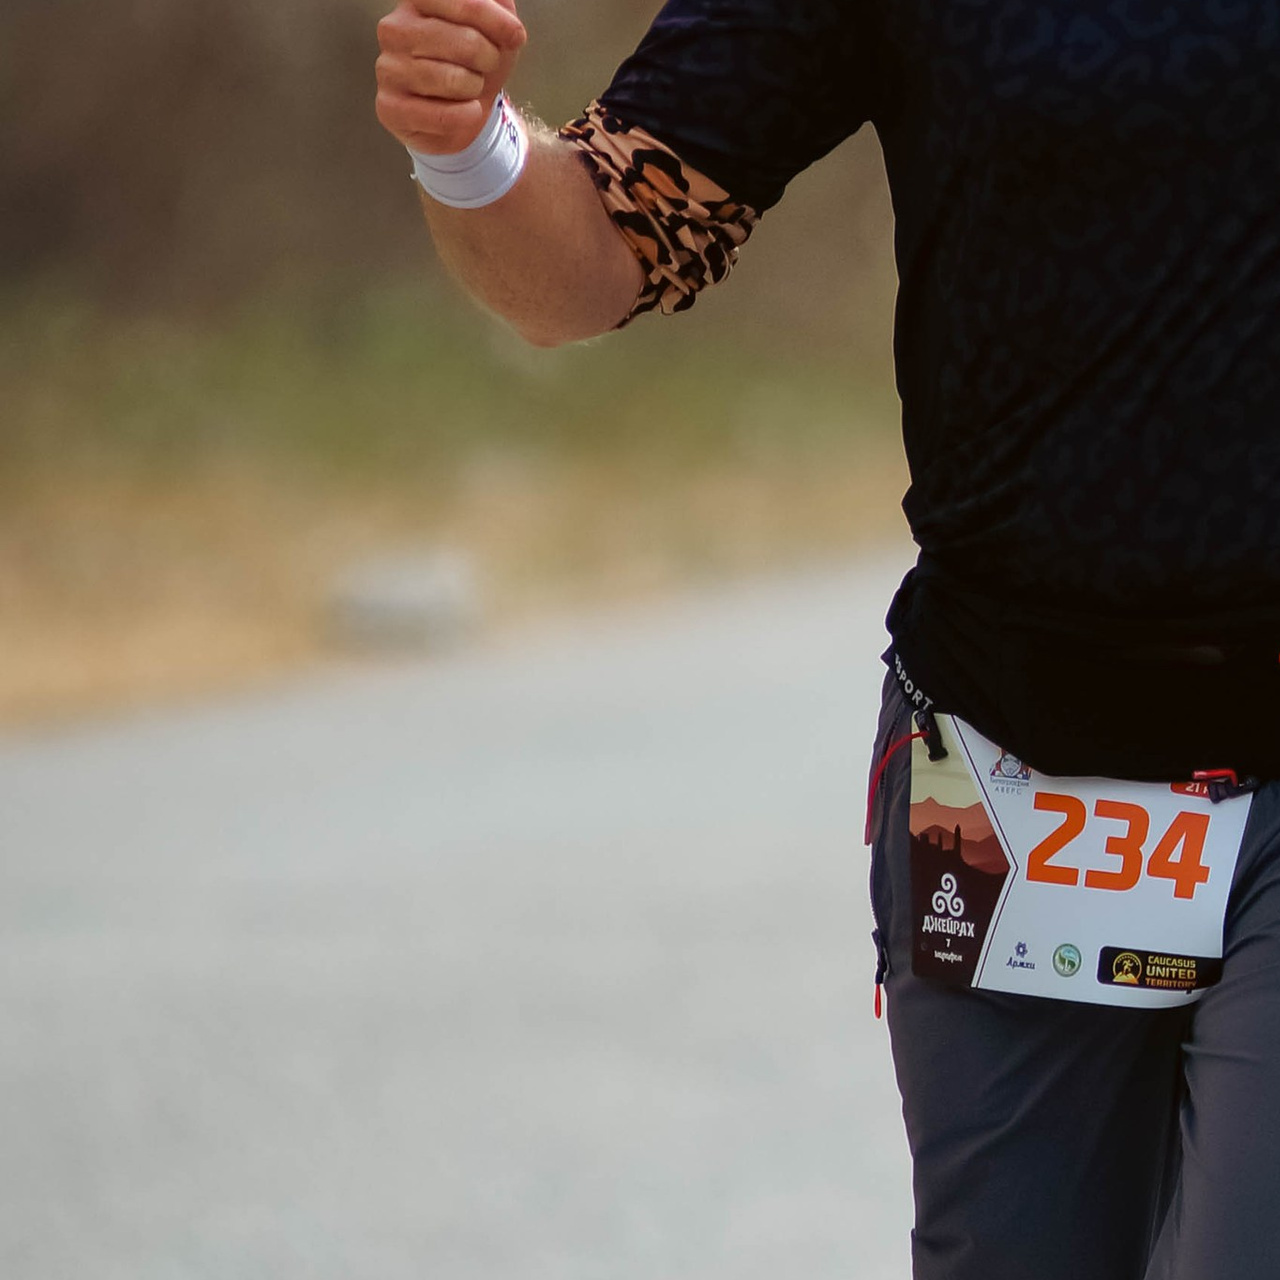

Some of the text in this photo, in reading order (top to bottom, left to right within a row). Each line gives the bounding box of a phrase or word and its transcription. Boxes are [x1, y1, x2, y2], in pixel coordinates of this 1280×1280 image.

[1026, 791, 1211, 900] 234
[922, 915, 975, 938] ДЖЕЙРАХ
[1148, 955, 1196, 968] CAUCASUS
[1146, 966, 1197, 980] UNITED
